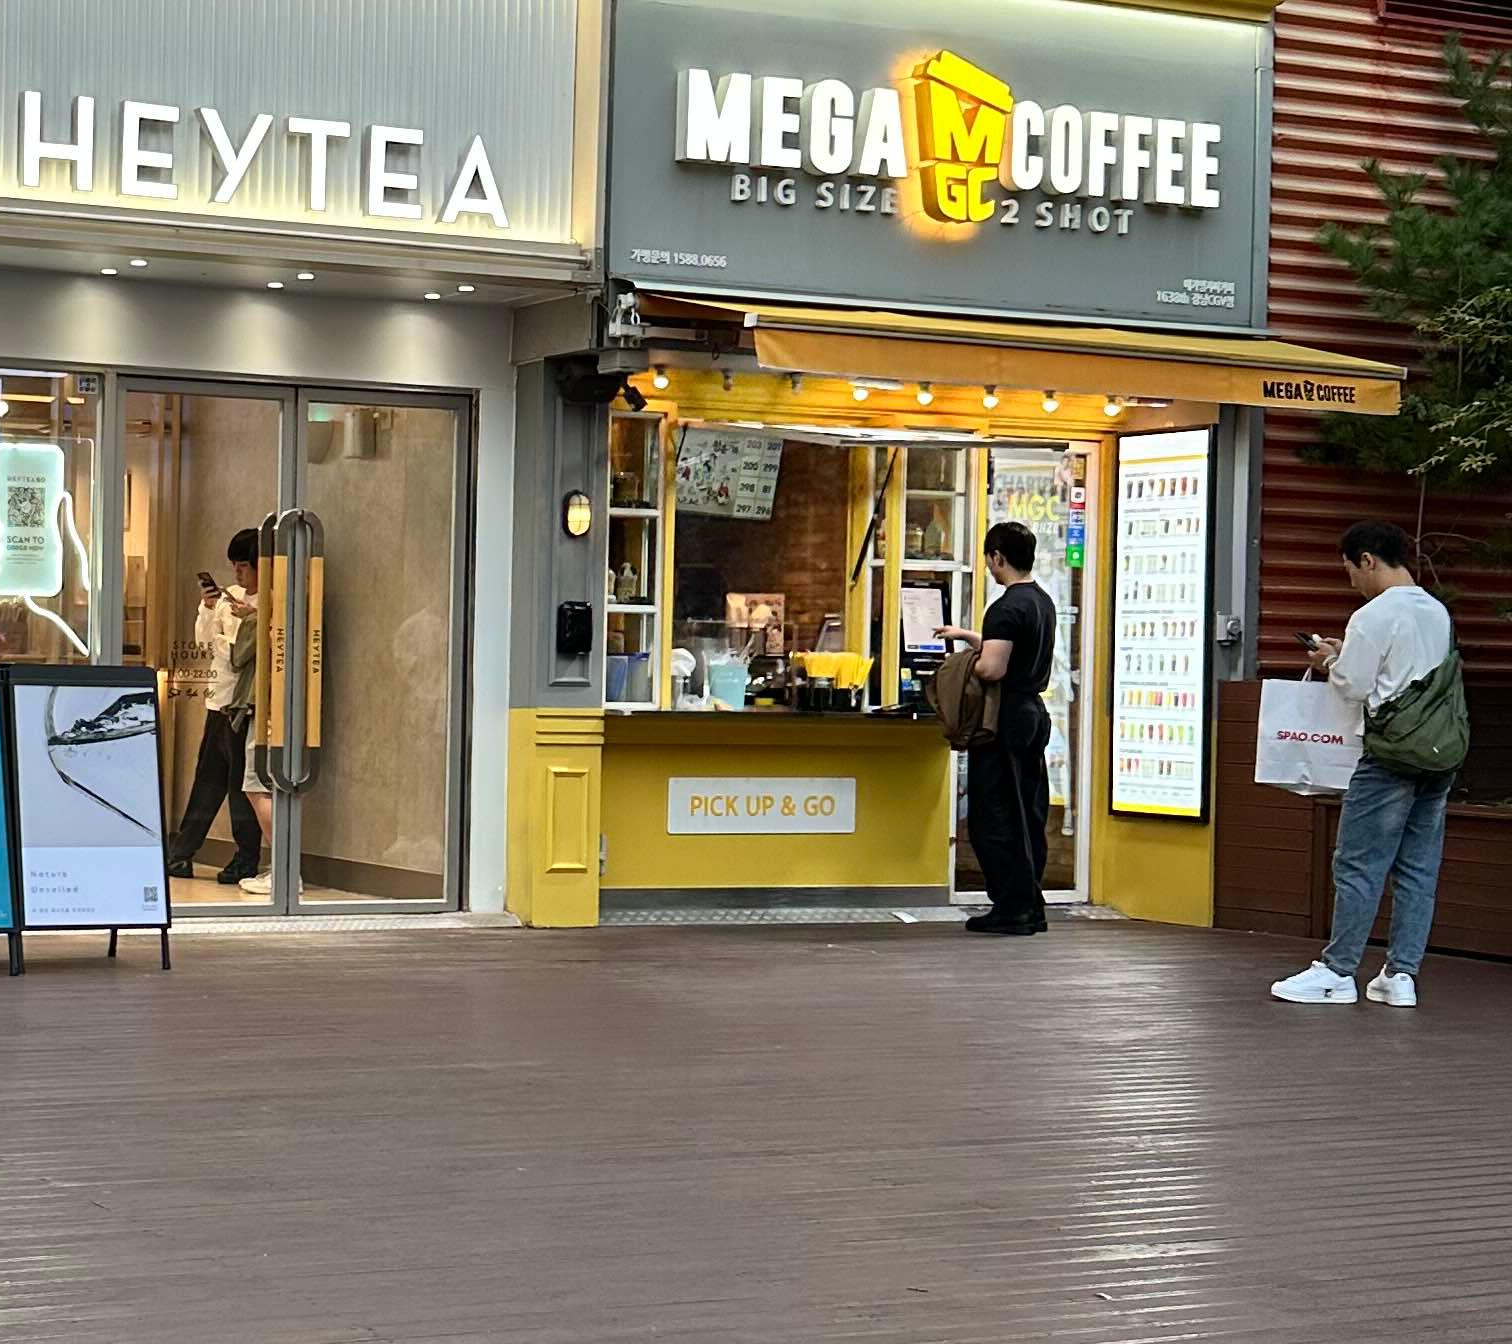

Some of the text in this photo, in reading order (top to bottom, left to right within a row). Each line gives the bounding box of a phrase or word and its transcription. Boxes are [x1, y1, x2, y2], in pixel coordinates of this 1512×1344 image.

[675, 67, 1222, 209] MEGA COFFEE
[18, 89, 510, 230] HEYTEA
[730, 174, 1135, 236] BIG SIZE 2 SHOT
[1263, 380, 1356, 403] MEGA COFFEE
[1008, 494, 1061, 521] MGC
[171, 651, 215, 660] HOURS
[173, 640, 213, 651] STORE
[276, 628, 284, 673] HEYTEA
[1277, 730, 1344, 745] SPAO.COM
[690, 795, 836, 817] PICK UP & GO
